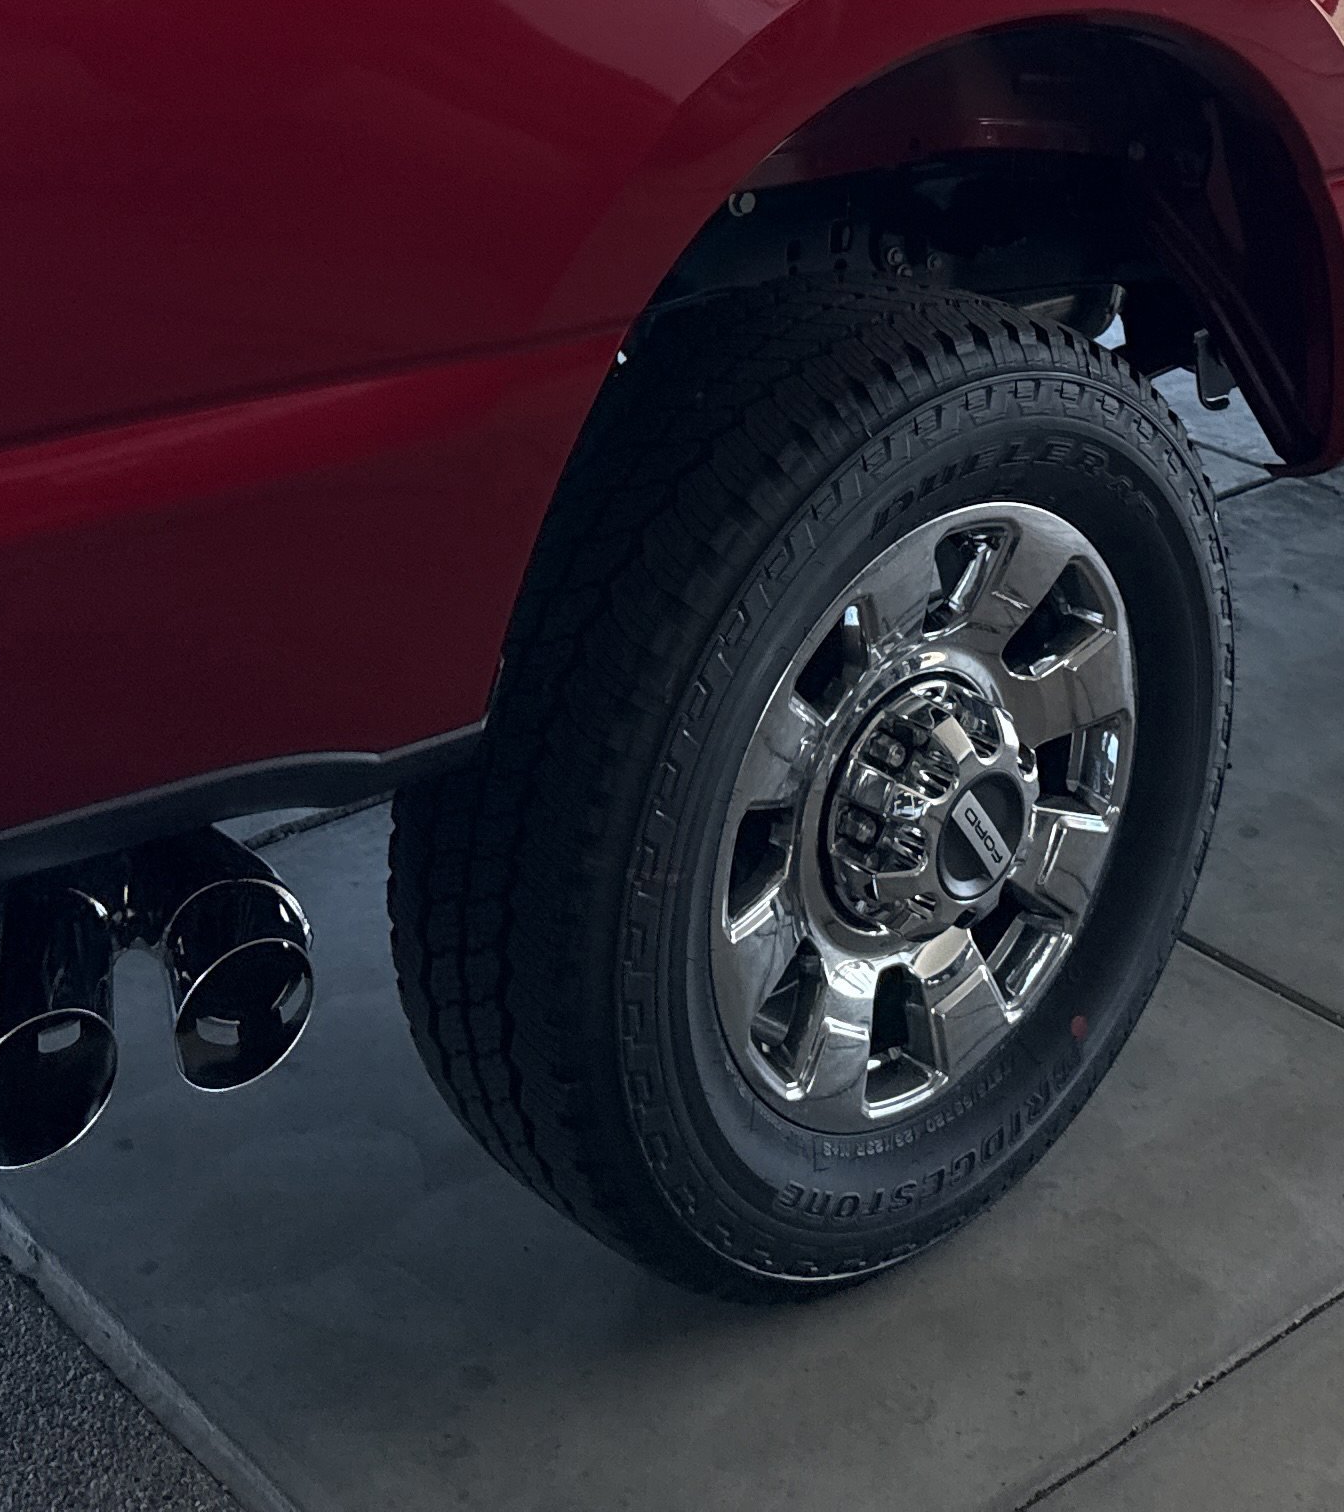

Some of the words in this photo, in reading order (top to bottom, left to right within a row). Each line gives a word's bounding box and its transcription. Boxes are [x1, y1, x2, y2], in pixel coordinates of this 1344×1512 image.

[871, 440, 1107, 540] DUELER
[965, 807, 1003, 864] FORD
[773, 1050, 1080, 1220] BRIDGESTONE
